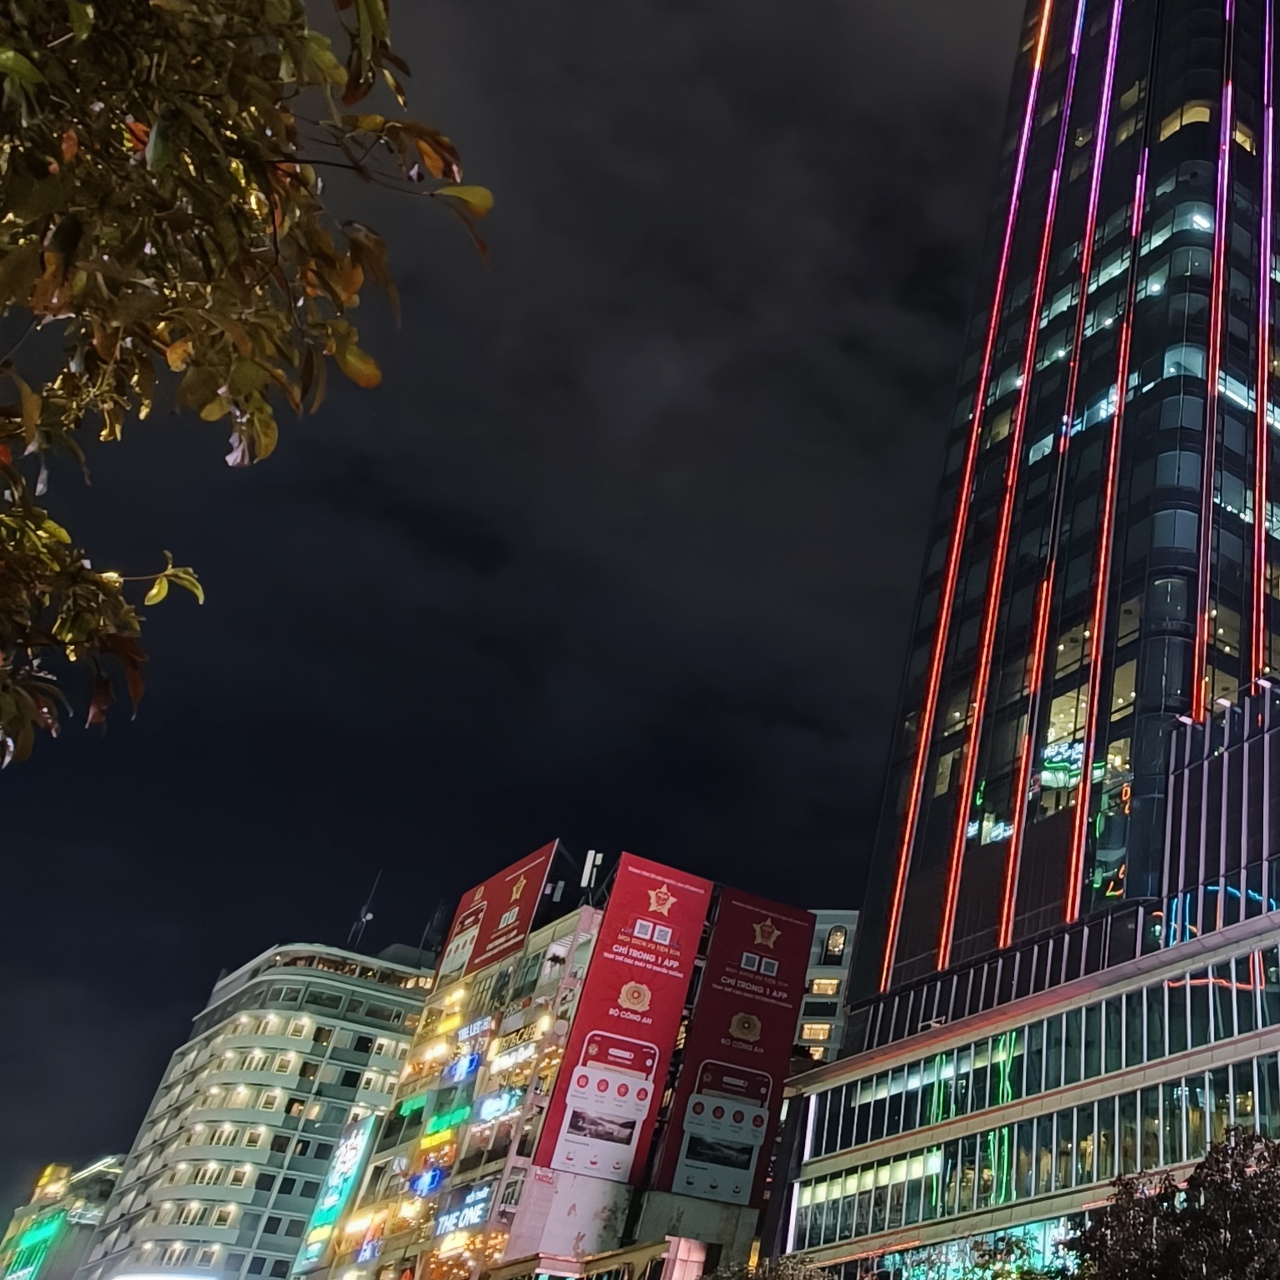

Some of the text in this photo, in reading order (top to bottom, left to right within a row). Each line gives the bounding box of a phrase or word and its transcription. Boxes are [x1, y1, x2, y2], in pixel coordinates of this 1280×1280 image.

[628, 948, 656, 962] TRONG
[662, 958, 680, 968] APP
[436, 1203, 486, 1236] THE ONE
